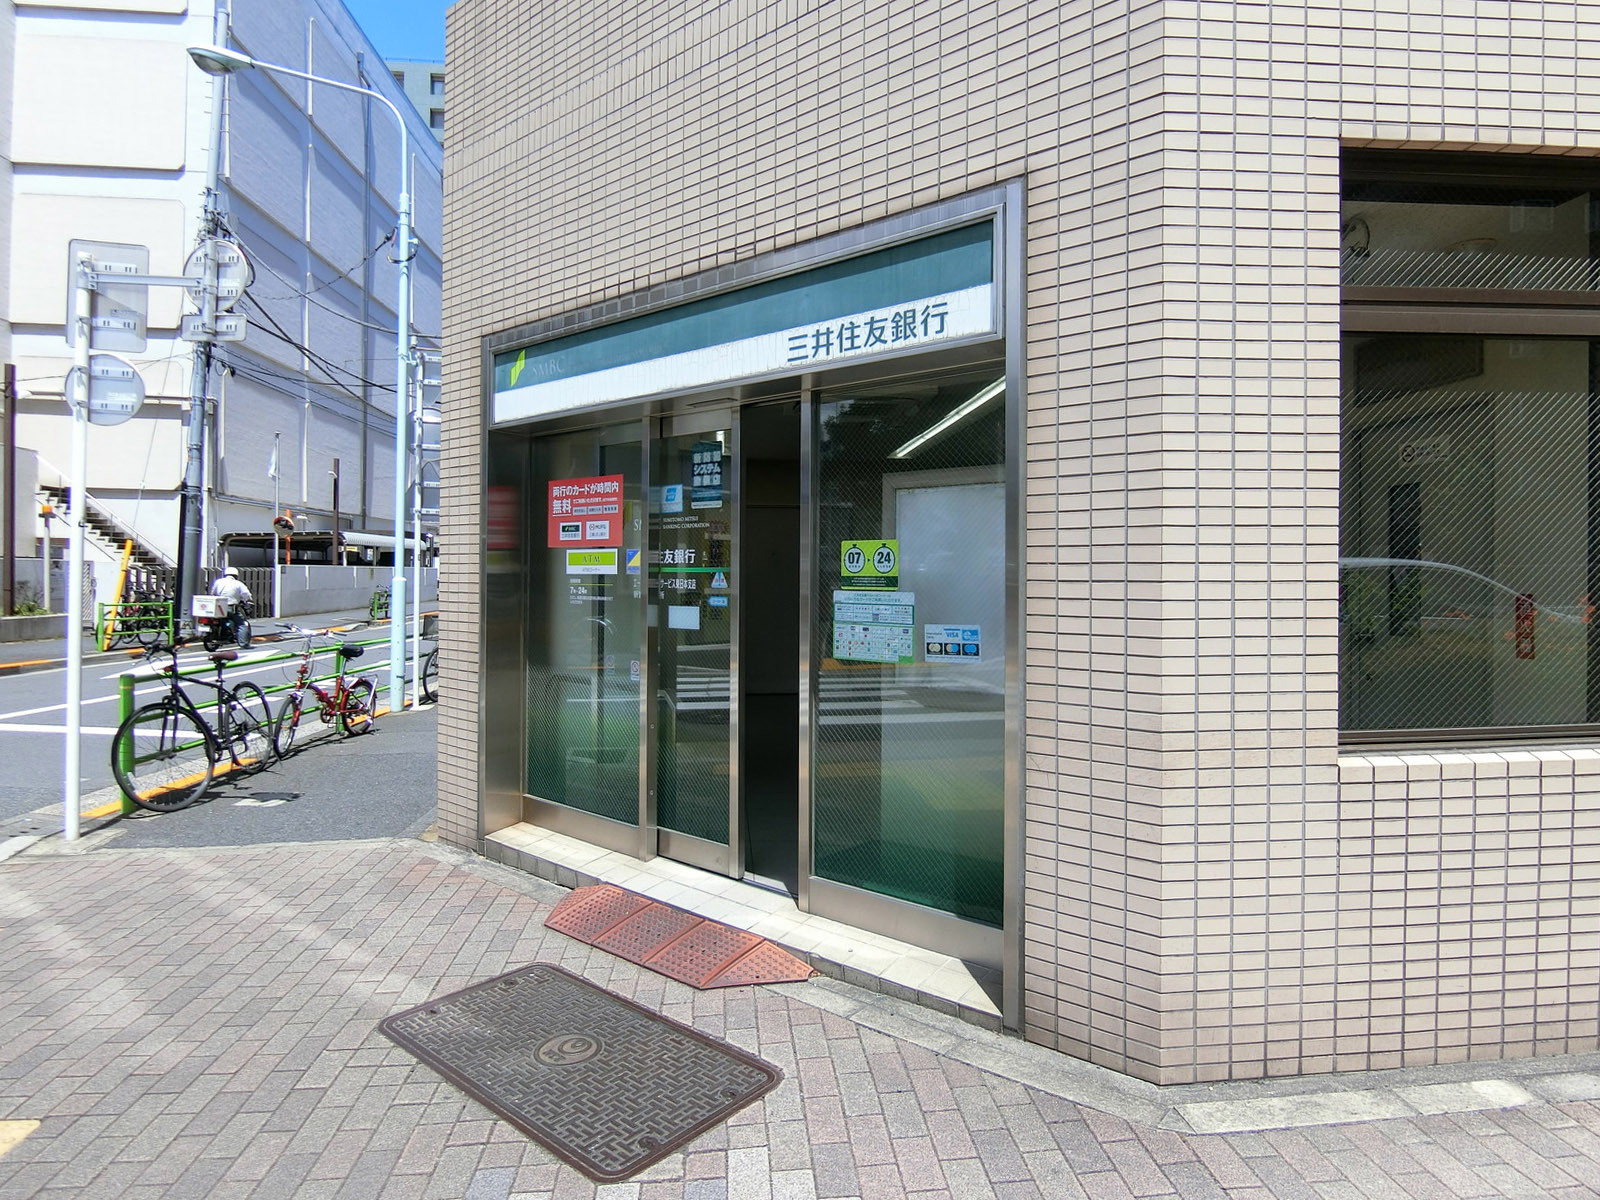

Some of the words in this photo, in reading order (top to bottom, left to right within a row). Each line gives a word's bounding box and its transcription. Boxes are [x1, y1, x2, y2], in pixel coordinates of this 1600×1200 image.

[787, 302, 949, 363] 三井住友銀行
[532, 355, 566, 377] SMBC
[693, 463, 721, 476] システム
[552, 481, 619, 497] 両行のカードが時間内
[552, 498, 571, 515] 無料
[583, 555, 600, 563] ATM
[848, 552, 861, 564] 07
[877, 551, 891, 564] 24
